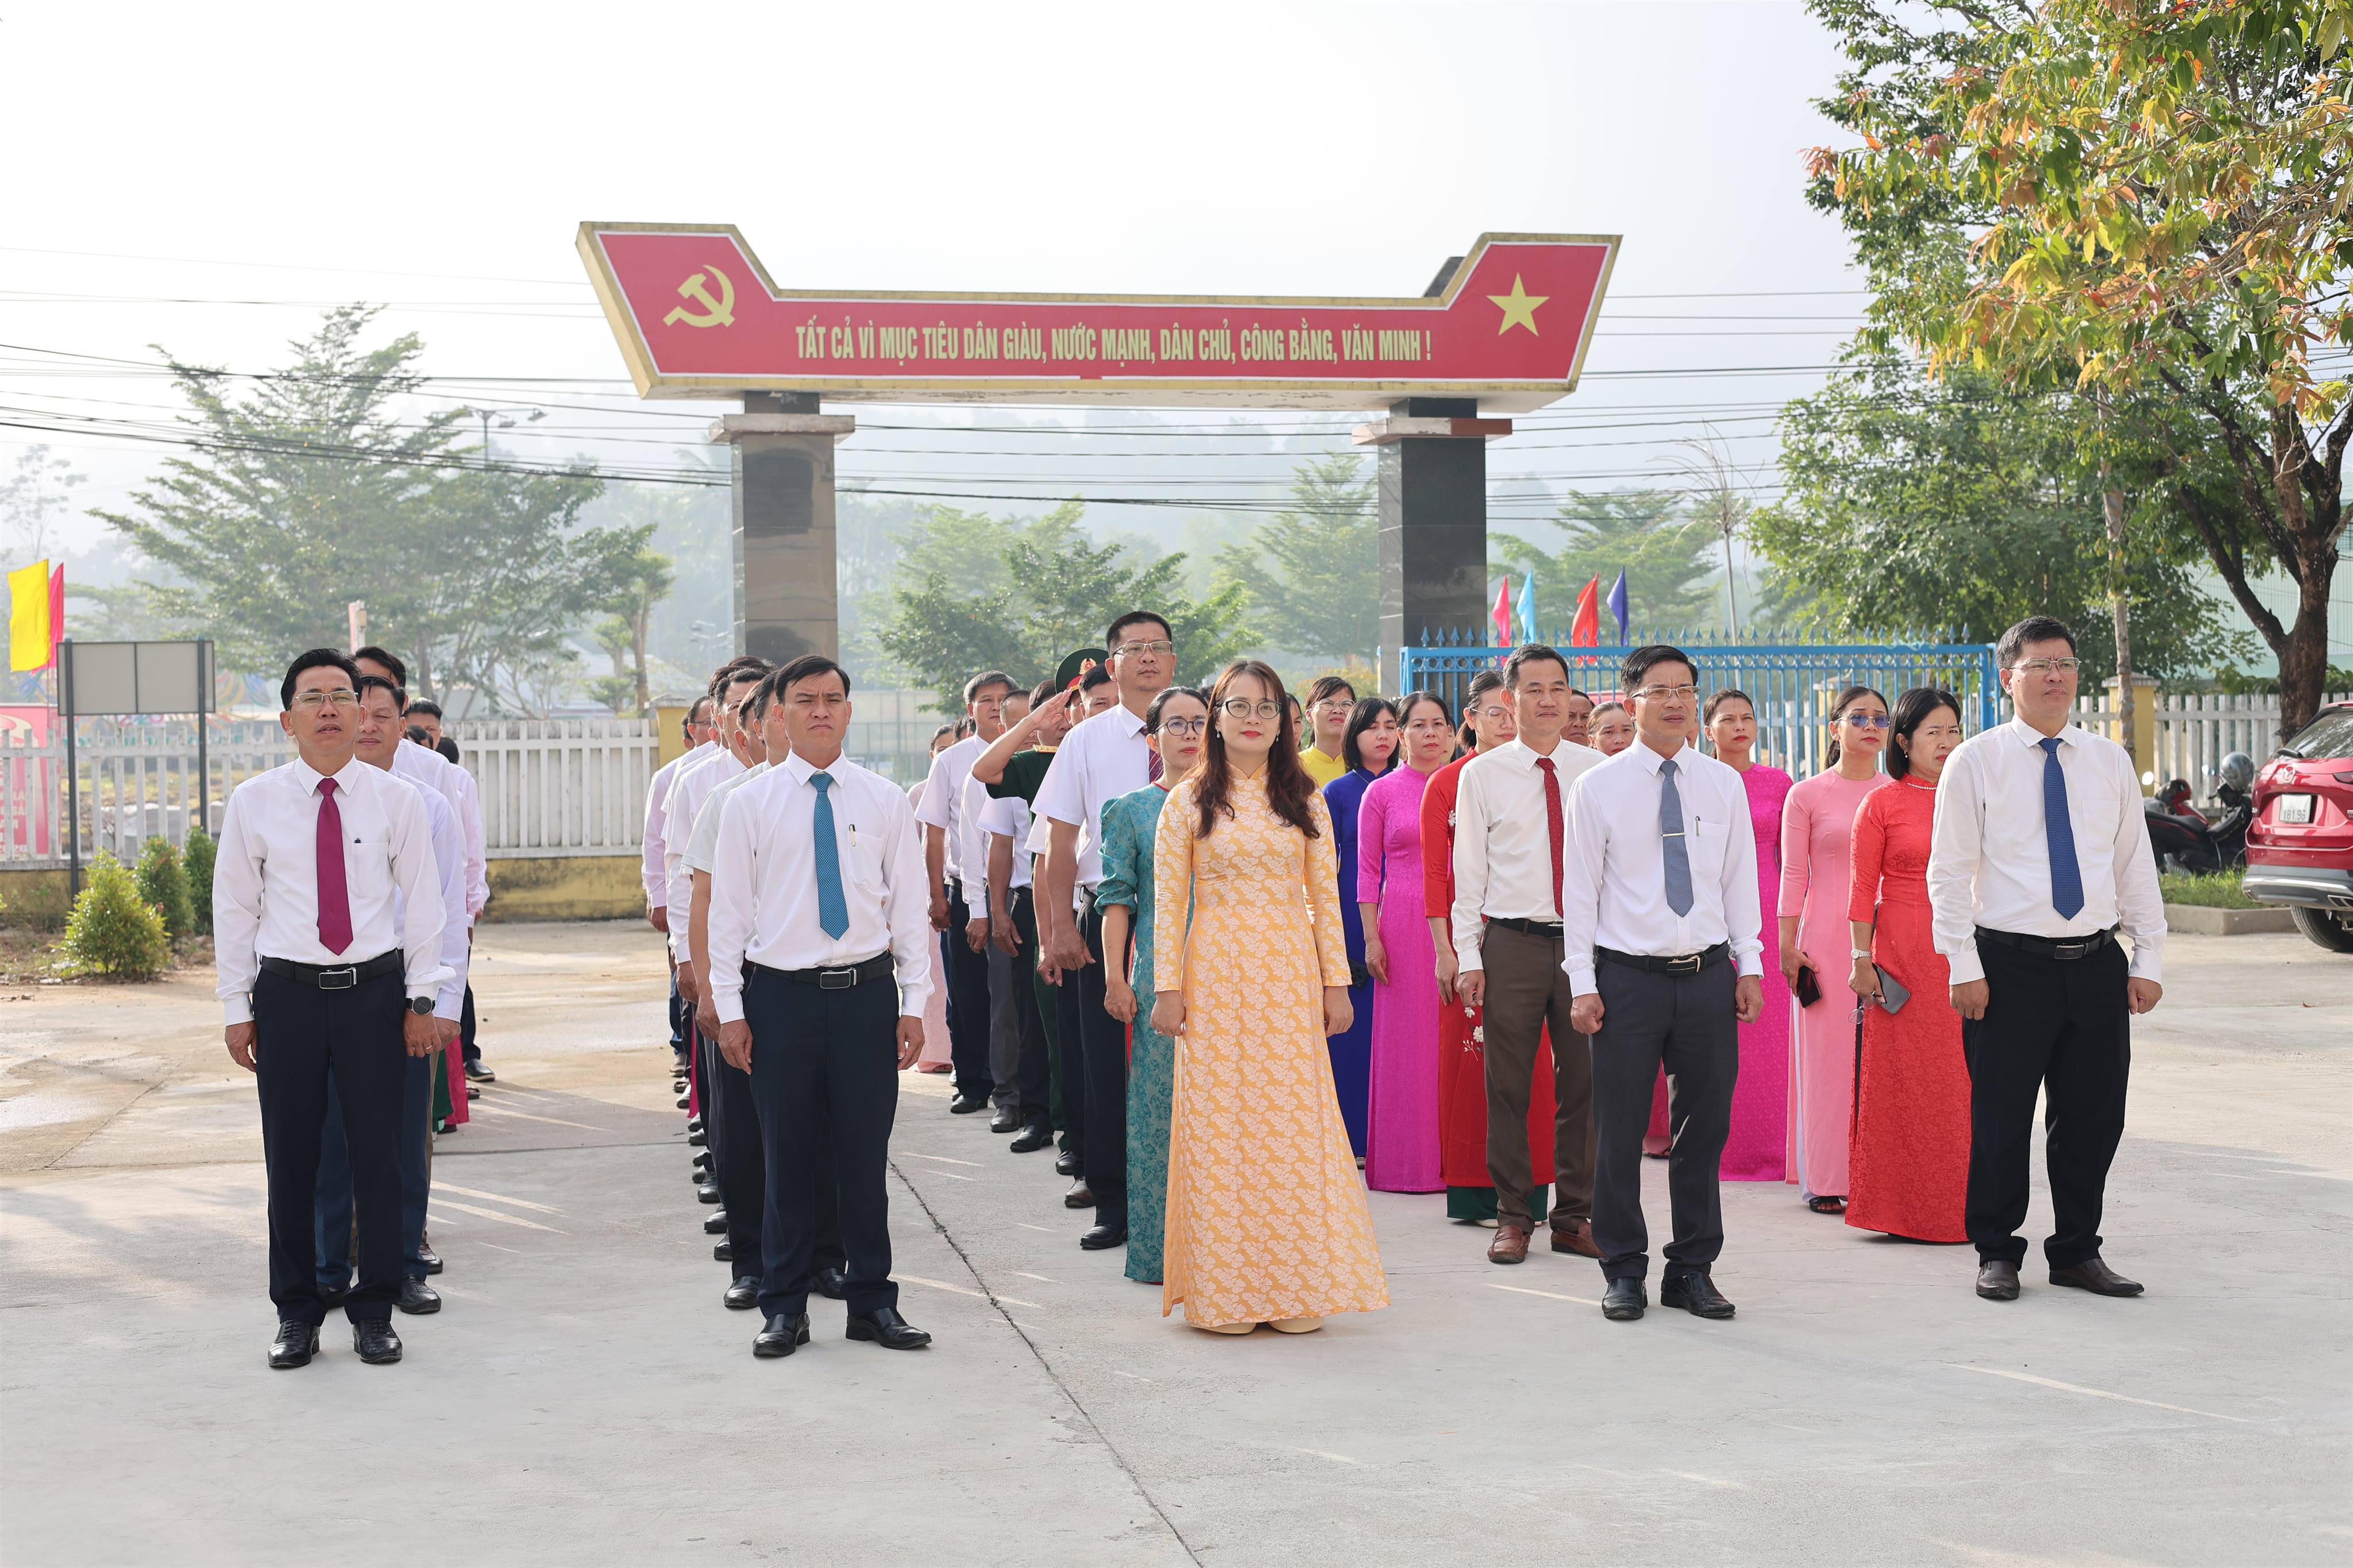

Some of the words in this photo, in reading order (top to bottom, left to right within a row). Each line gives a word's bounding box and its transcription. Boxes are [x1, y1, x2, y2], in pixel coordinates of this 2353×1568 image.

[796, 315, 826, 358] TẤT
[831, 316, 854, 359] CẢ
[858, 320, 875, 359] VÌ
[880, 327, 918, 366] MỤC
[922, 321, 959, 360] TIÊU
[963, 321, 998, 360] DÂN
[1003, 321, 1047, 363] GIÀU,
[1051, 322, 1097, 361] NƯỚC
[1101, 329, 1155, 368] MẠNH,
[1160, 322, 1194, 360] DÂN
[1198, 319, 1236, 364] CHỦ,
[1240, 323, 1284, 361] CÔNG
[1289, 318, 1337, 364] BẰNG,
[1341, 324, 1374, 361] VĂN
[1378, 330, 1421, 361] MINH
